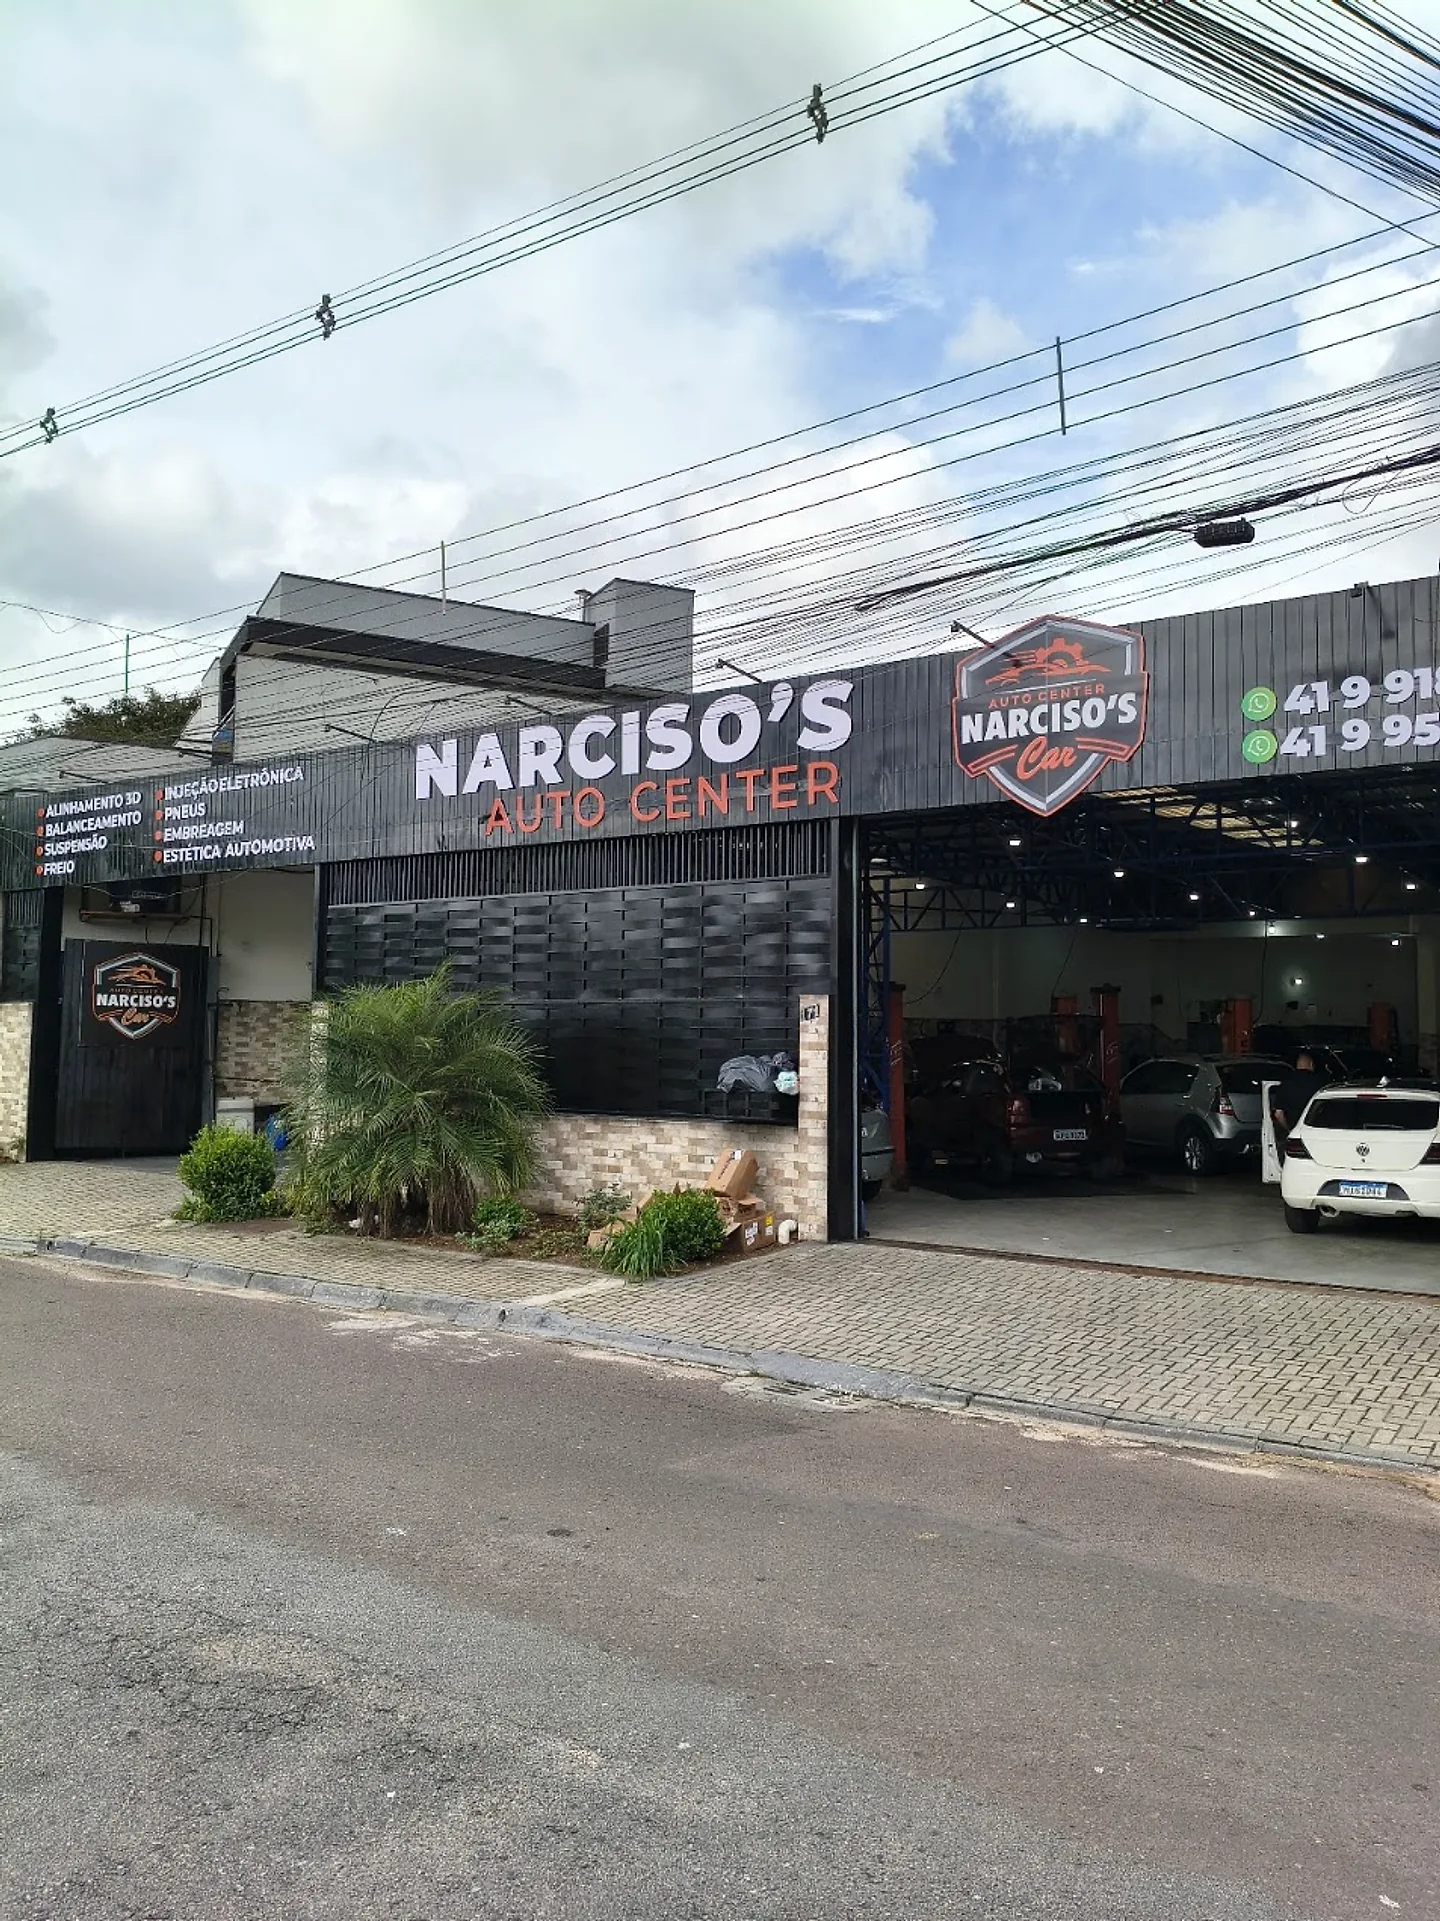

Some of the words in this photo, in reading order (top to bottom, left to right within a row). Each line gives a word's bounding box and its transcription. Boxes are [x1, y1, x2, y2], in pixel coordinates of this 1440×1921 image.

[988, 694, 1032, 709] AUTO
[1038, 683, 1105, 701] CENTER
[1284, 680, 1330, 714] 41
[1341, 675, 1371, 708] 9
[1384, 667, 1440, 704] 91
[961, 693, 1138, 745] NARCISO'S
[416, 679, 854, 800] NARCISO'S
[1280, 725, 1326, 756] 41
[1341, 718, 1370, 751] 9
[1016, 736, 1077, 780] Car
[46, 796, 123, 818] ALINHAMENTO
[125, 791, 141, 806] 3D
[164, 802, 206, 820] PNEUS
[484, 786, 604, 836] AUTO
[630, 761, 839, 822] CENTER
[45, 810, 141, 838] BALANCEAMENTO
[163, 821, 244, 842] EMBREAGEM
[44, 835, 107, 857] SUSPENSÃO
[163, 843, 222, 863] ESTÉTICA
[225, 835, 315, 857] AUTOMOTIVA
[43, 861, 75, 876] FREIO
[96, 993, 177, 1008] NARCISO'S
